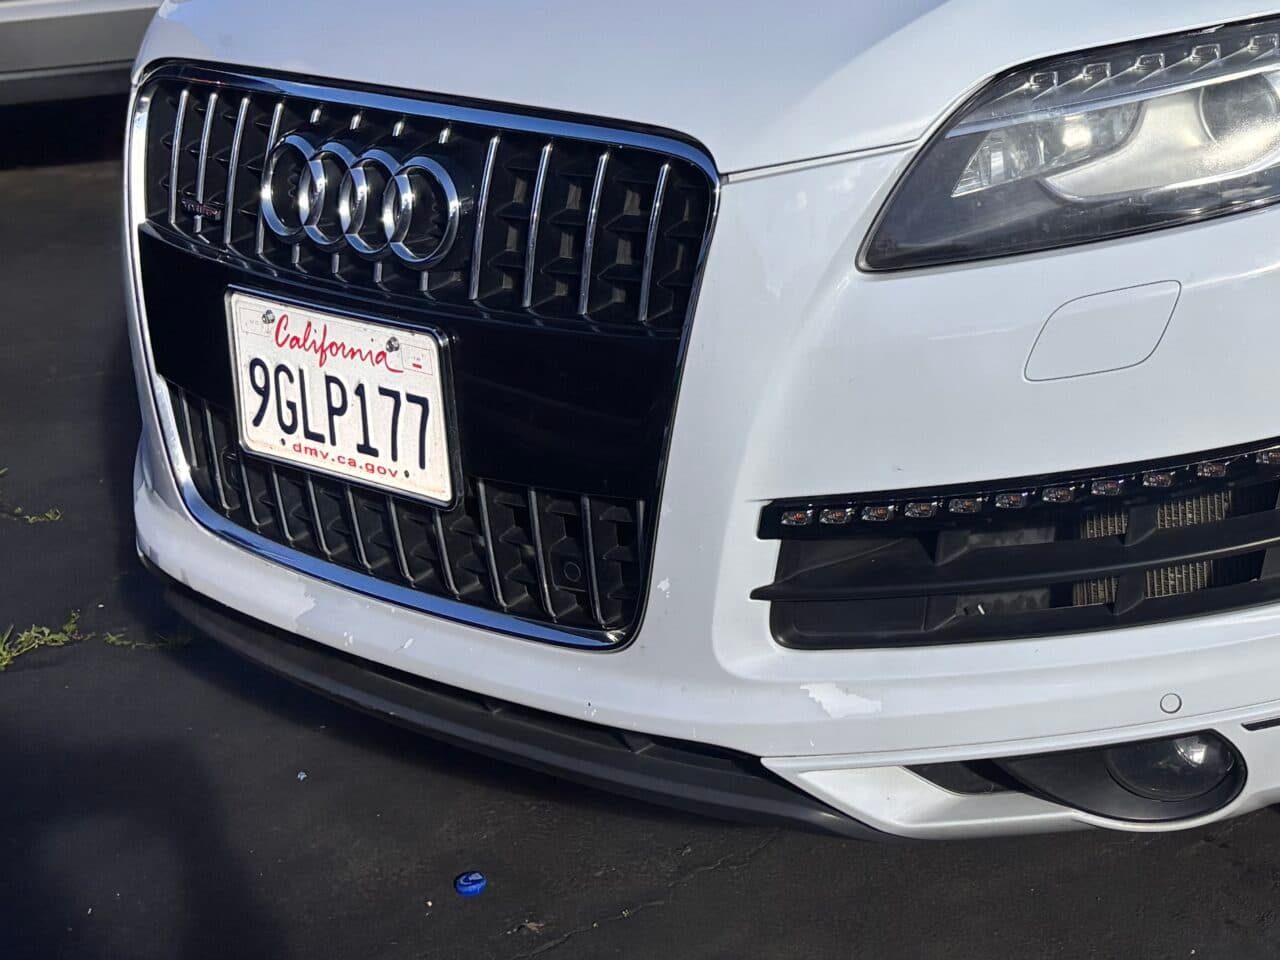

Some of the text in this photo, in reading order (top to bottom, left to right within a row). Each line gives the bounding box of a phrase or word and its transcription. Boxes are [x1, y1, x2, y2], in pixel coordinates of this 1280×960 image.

[274, 314, 404, 373] California
[249, 357, 430, 470] 9GLP177
[293, 442, 398, 479] dmv.ca.gov
